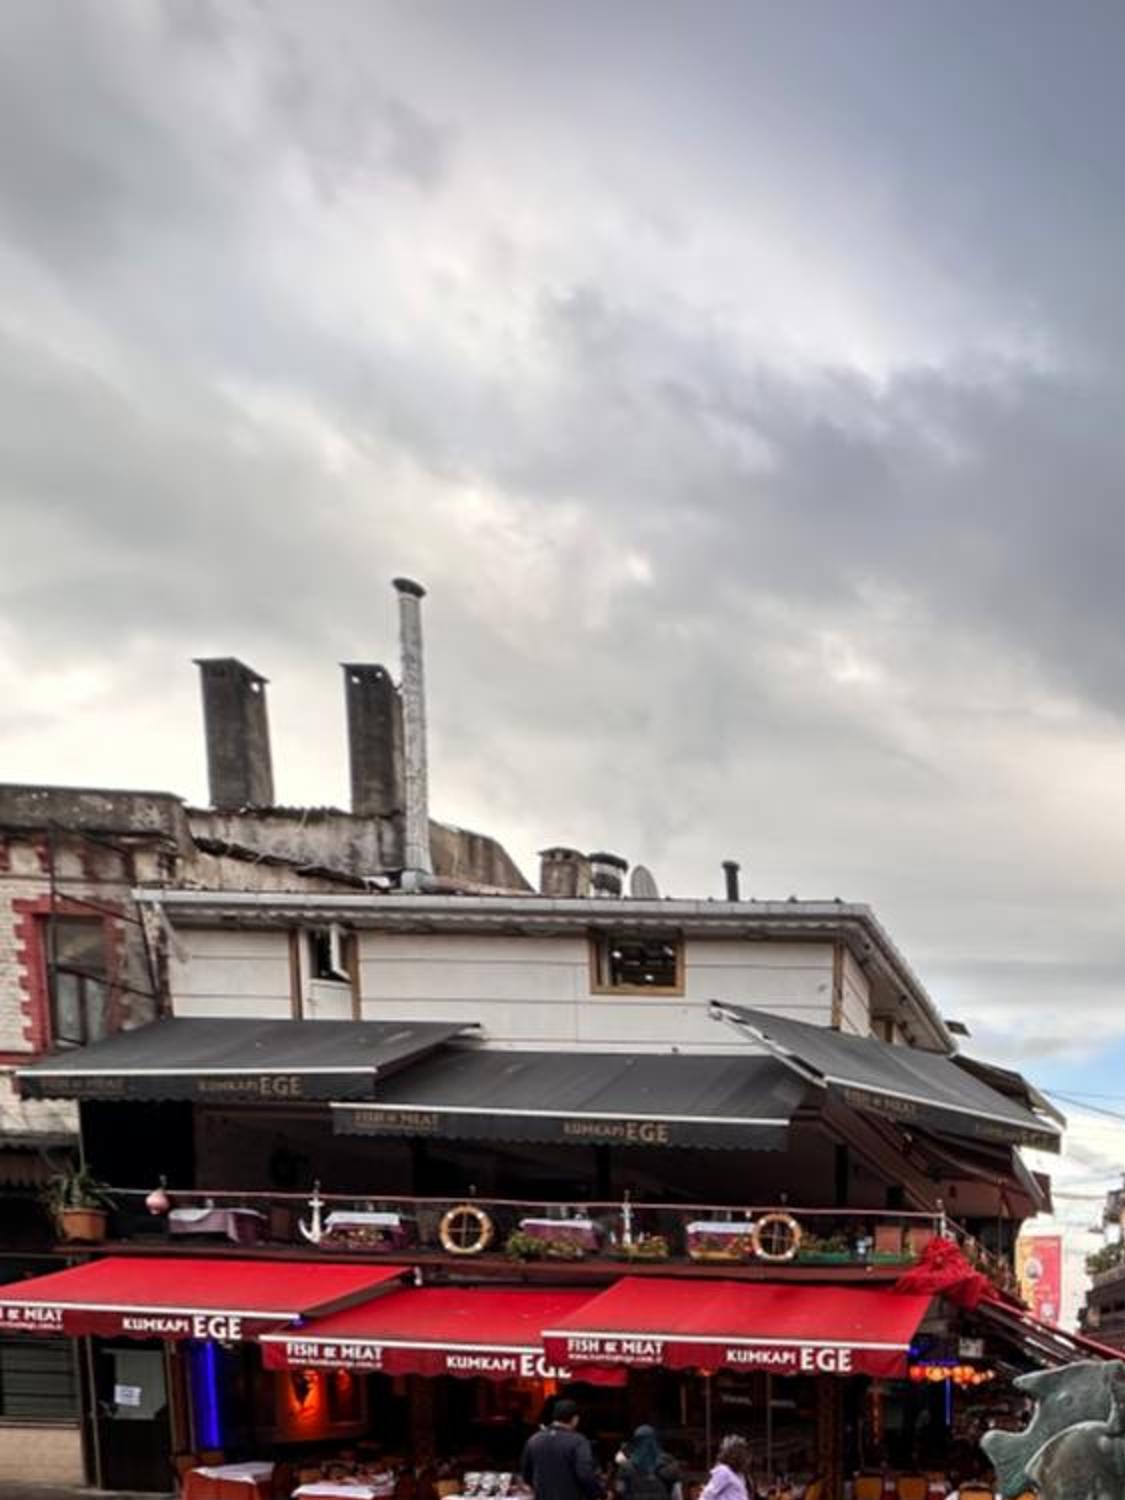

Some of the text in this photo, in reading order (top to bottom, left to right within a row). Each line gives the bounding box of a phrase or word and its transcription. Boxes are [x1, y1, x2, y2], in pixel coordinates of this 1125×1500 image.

[260, 1076, 303, 1096] EGE
[400, 1112, 439, 1126] MEAT
[563, 1121, 670, 1143] KUMKAPI EGE
[24, 1308, 64, 1321] MEAT
[122, 1315, 242, 1340] KUMKAPI EGE
[286, 1341, 320, 1357] FISH
[341, 1344, 383, 1361] MEAT
[567, 1338, 600, 1353] FISH
[621, 1340, 664, 1355] MEAT
[446, 1356, 516, 1371] KUMKAPI
[726, 1347, 853, 1372] KUMKAPI EGE
